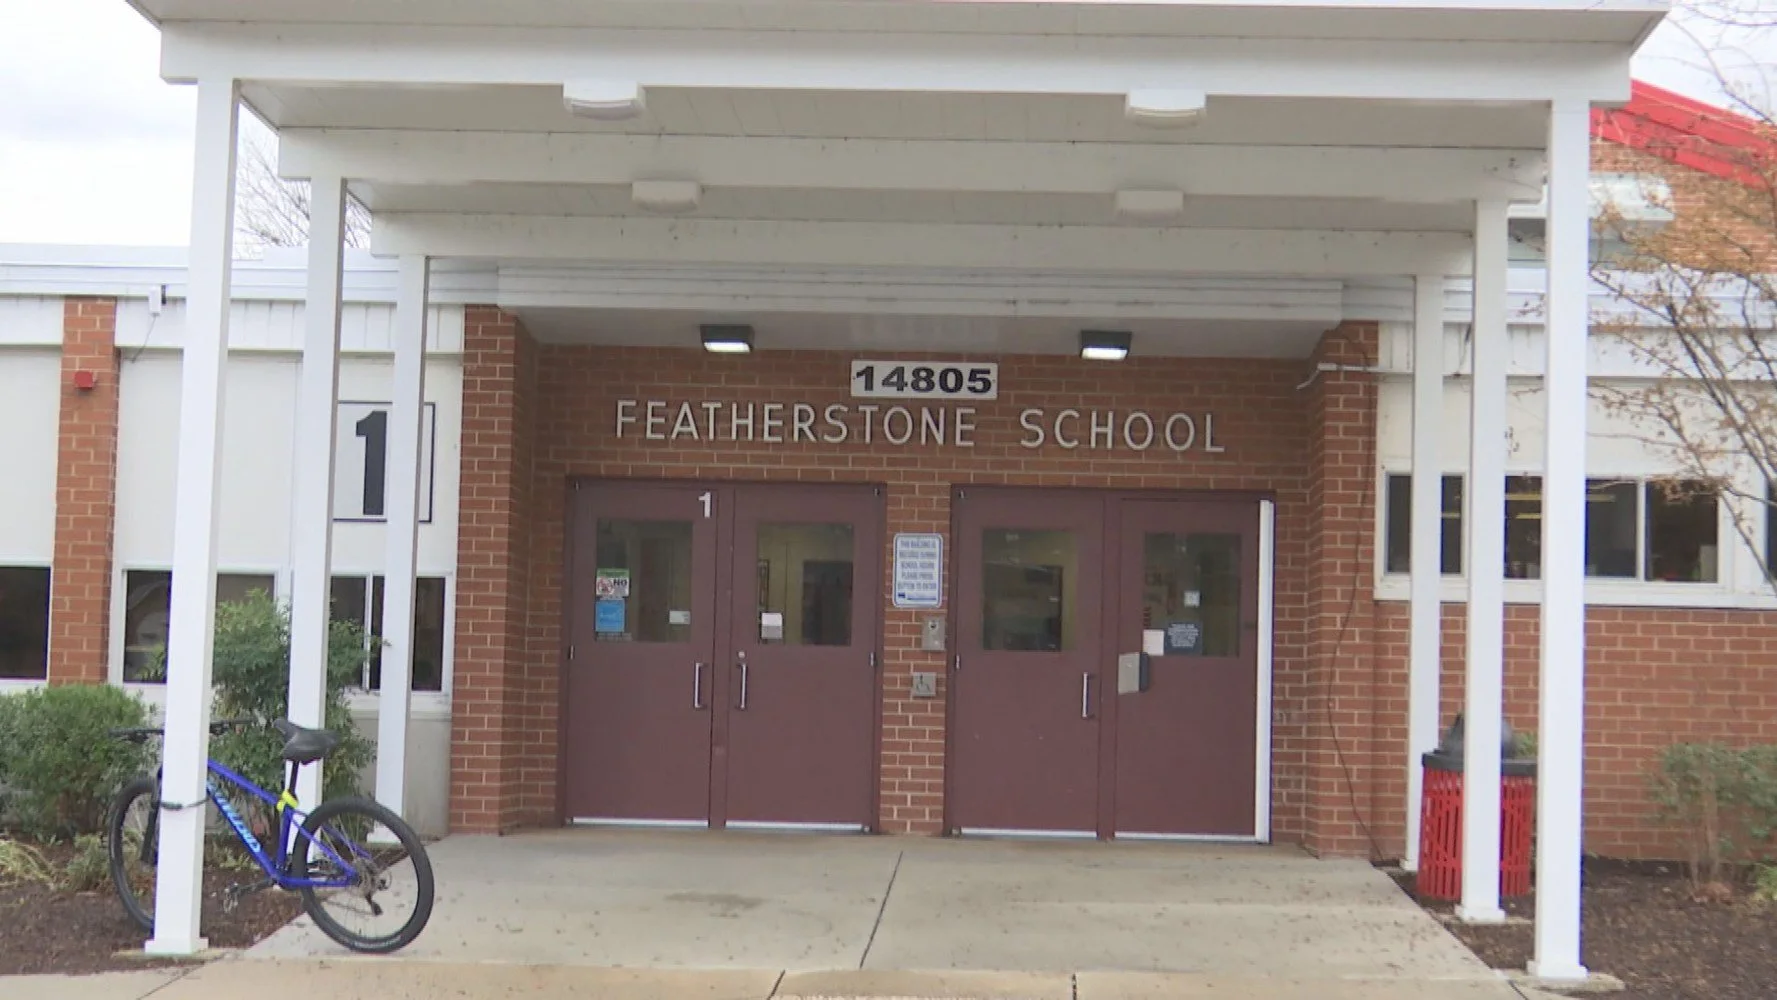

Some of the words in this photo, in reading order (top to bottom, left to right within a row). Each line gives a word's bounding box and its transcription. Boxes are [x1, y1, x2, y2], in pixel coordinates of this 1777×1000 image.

[855, 365, 993, 394] 14805
[615, 399, 977, 447] FEATHERSTONE
[1018, 408, 1226, 453] SCHOOL
[355, 410, 388, 516] 1
[698, 491, 711, 518] 1
